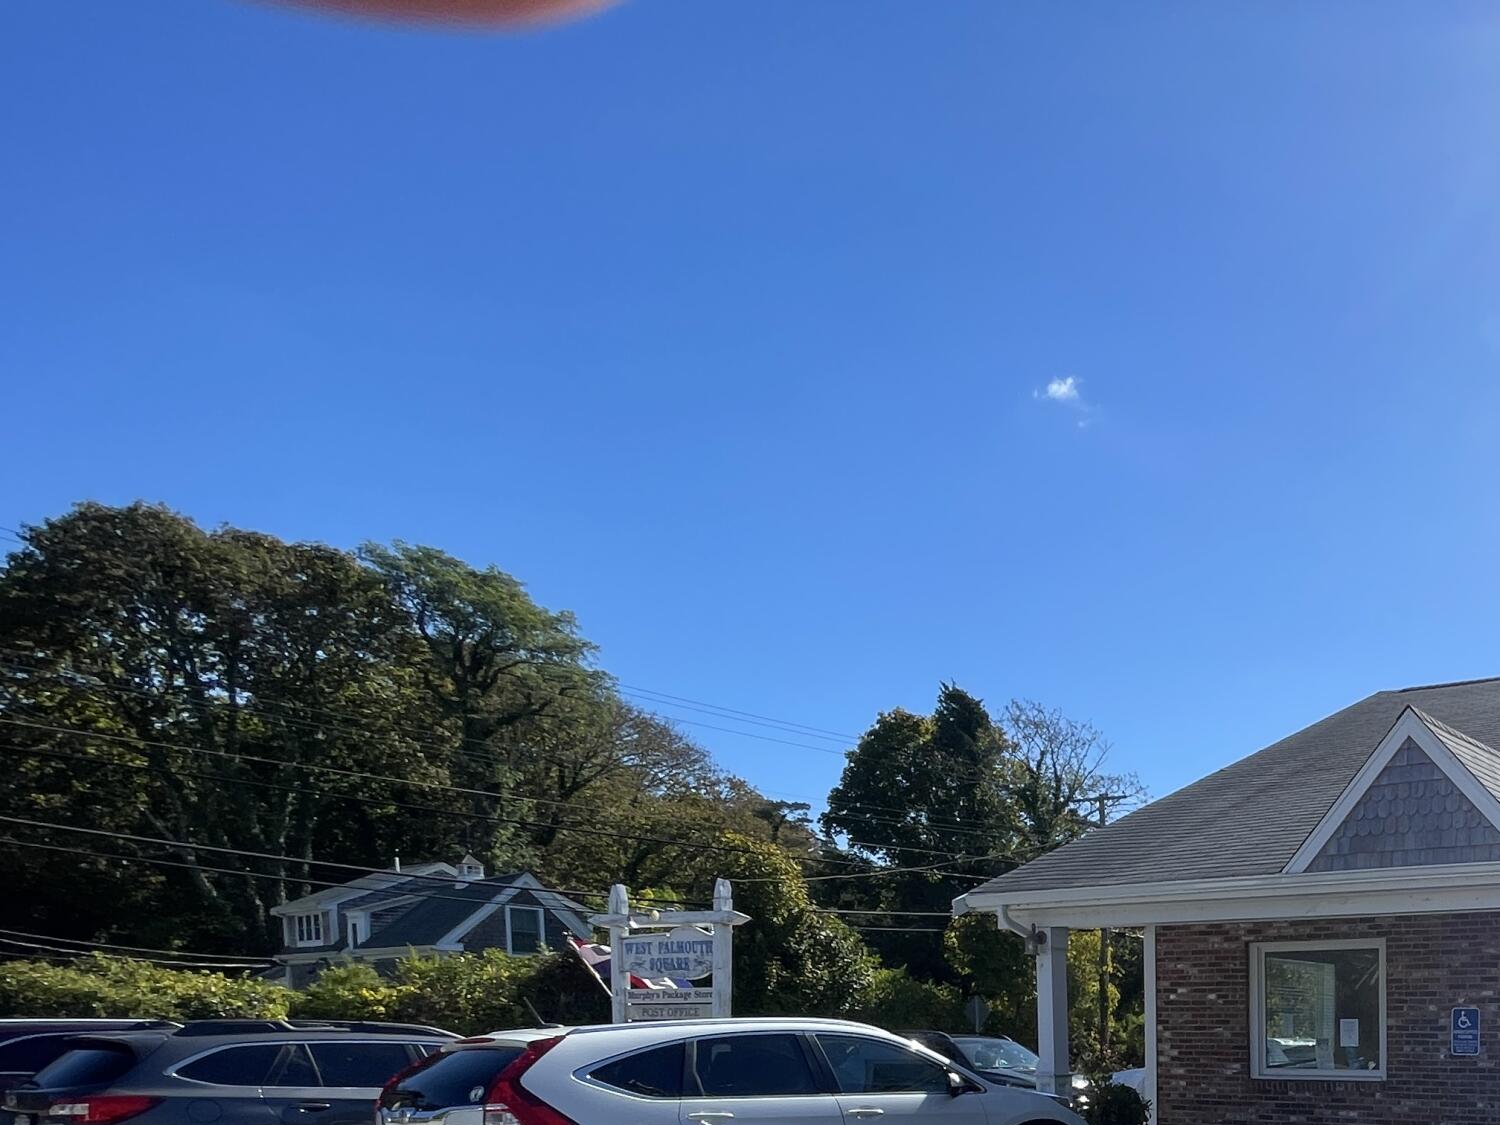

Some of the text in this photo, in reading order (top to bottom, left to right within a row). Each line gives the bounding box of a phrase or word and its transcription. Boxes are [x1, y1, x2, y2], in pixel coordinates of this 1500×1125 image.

[624, 942, 652, 955] WEST
[649, 957, 690, 973] SQUARE
[662, 990, 691, 1001] Package
[642, 1007, 700, 1017] POST OFFICE
